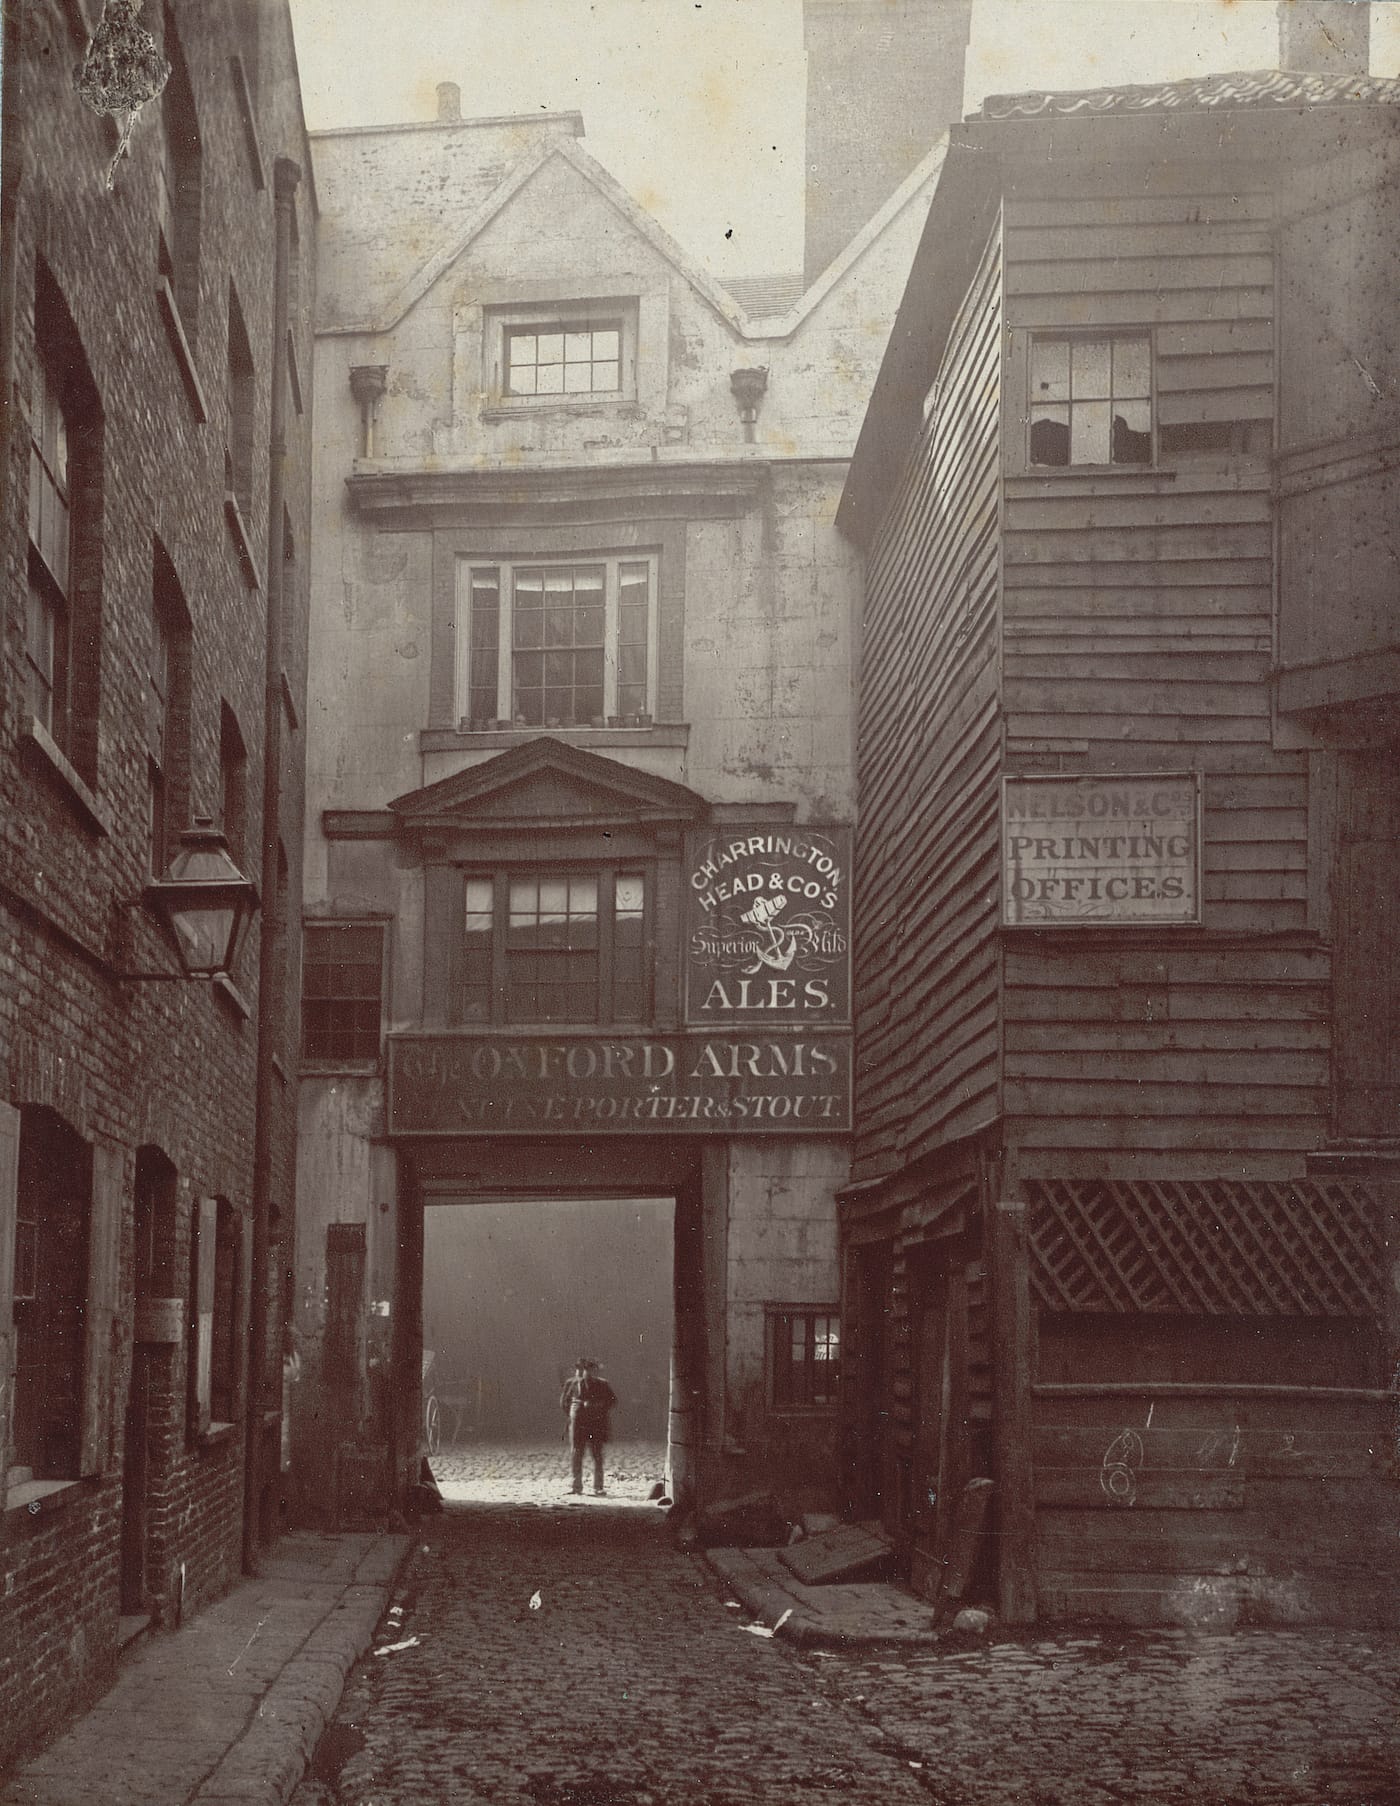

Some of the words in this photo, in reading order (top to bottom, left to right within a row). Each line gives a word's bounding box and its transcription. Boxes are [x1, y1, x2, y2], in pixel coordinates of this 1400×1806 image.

[1008, 836, 1190, 860] PRINTING
[691, 835, 846, 890] CHARRINGTON
[1011, 877, 1191, 900] OFFICES.
[692, 932, 760, 957] Superior
[701, 979, 836, 1009] ALES.
[471, 1045, 674, 1079] OXFORD
[689, 1044, 838, 1077] ARMS
